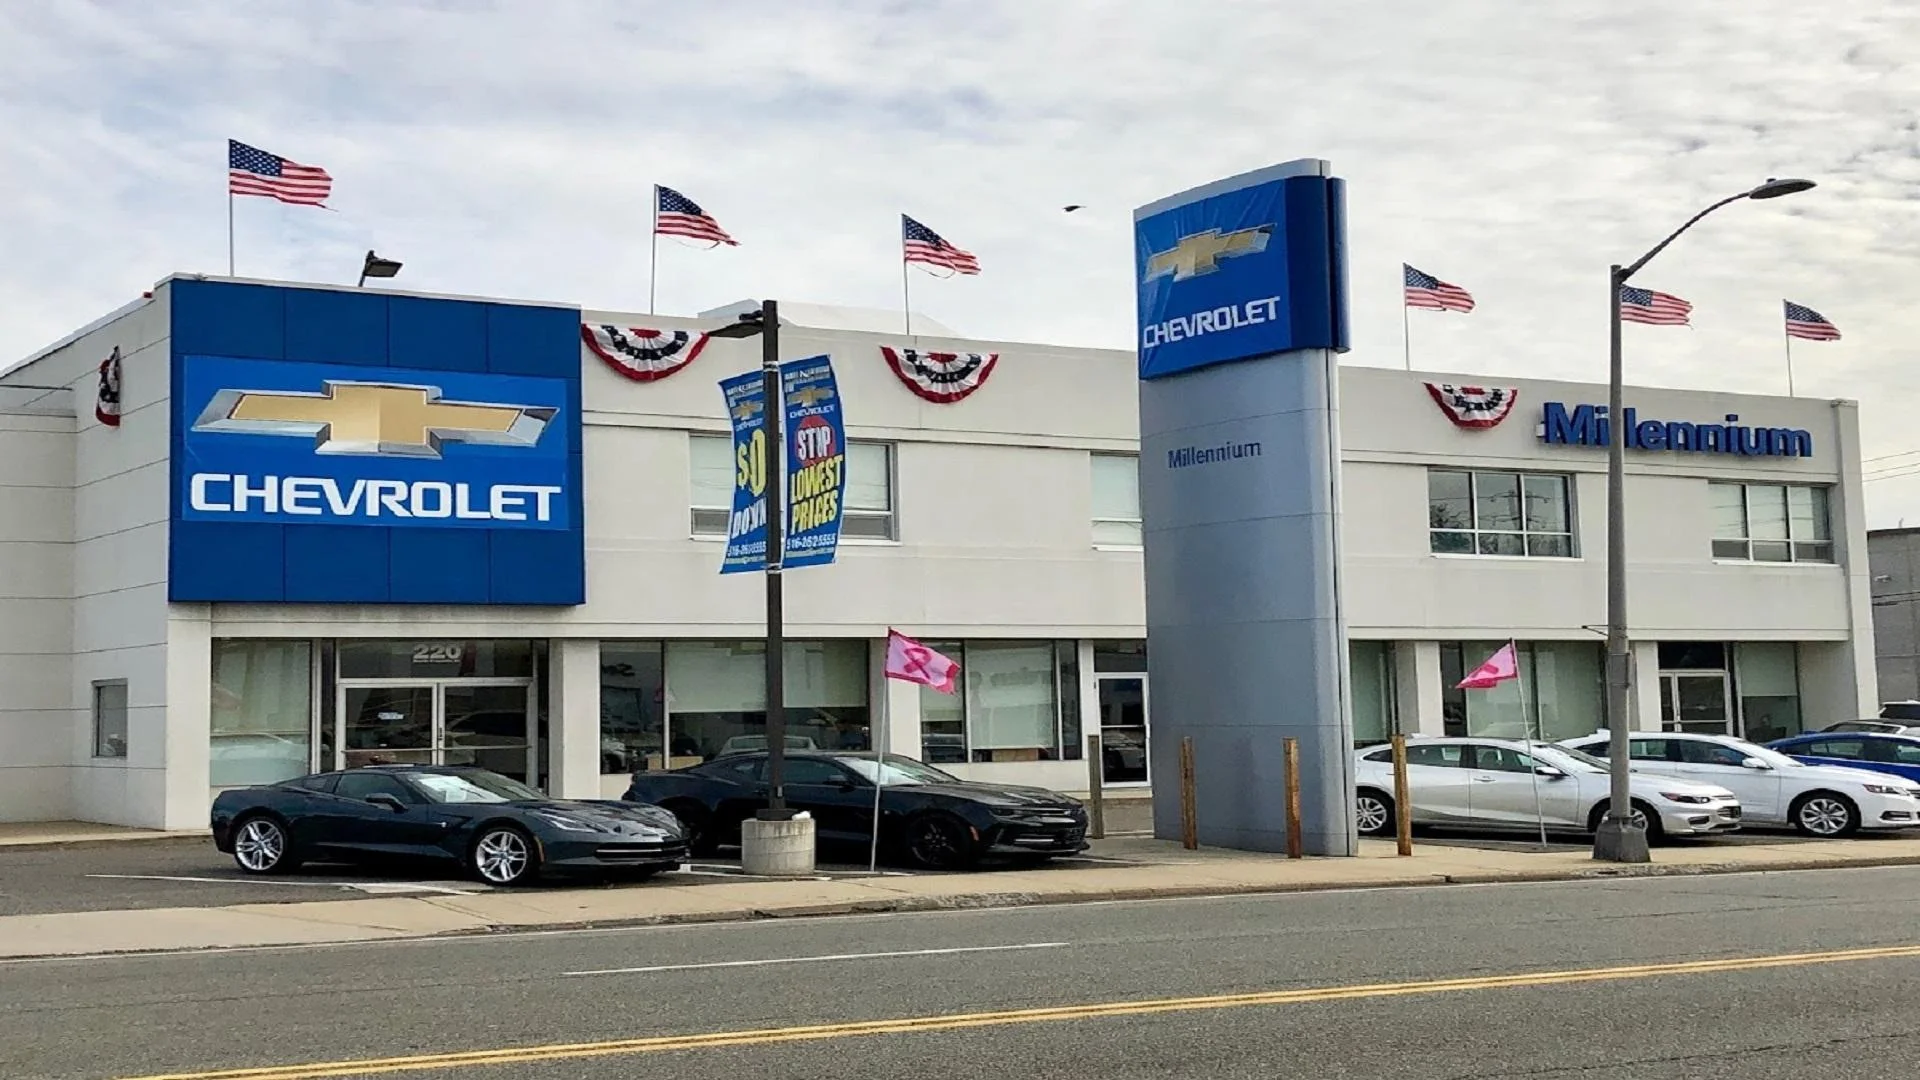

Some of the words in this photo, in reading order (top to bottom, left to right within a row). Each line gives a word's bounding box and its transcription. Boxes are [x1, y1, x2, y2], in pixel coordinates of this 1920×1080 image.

[1143, 296, 1280, 348] CHEVROLET
[1543, 402, 1812, 457] Milennium
[790, 454, 843, 504] LOWEST
[1168, 442, 1261, 468] Millennium
[190, 473, 562, 522] CHEVROLET
[790, 490, 839, 535] PRICES
[413, 643, 461, 659] 220
